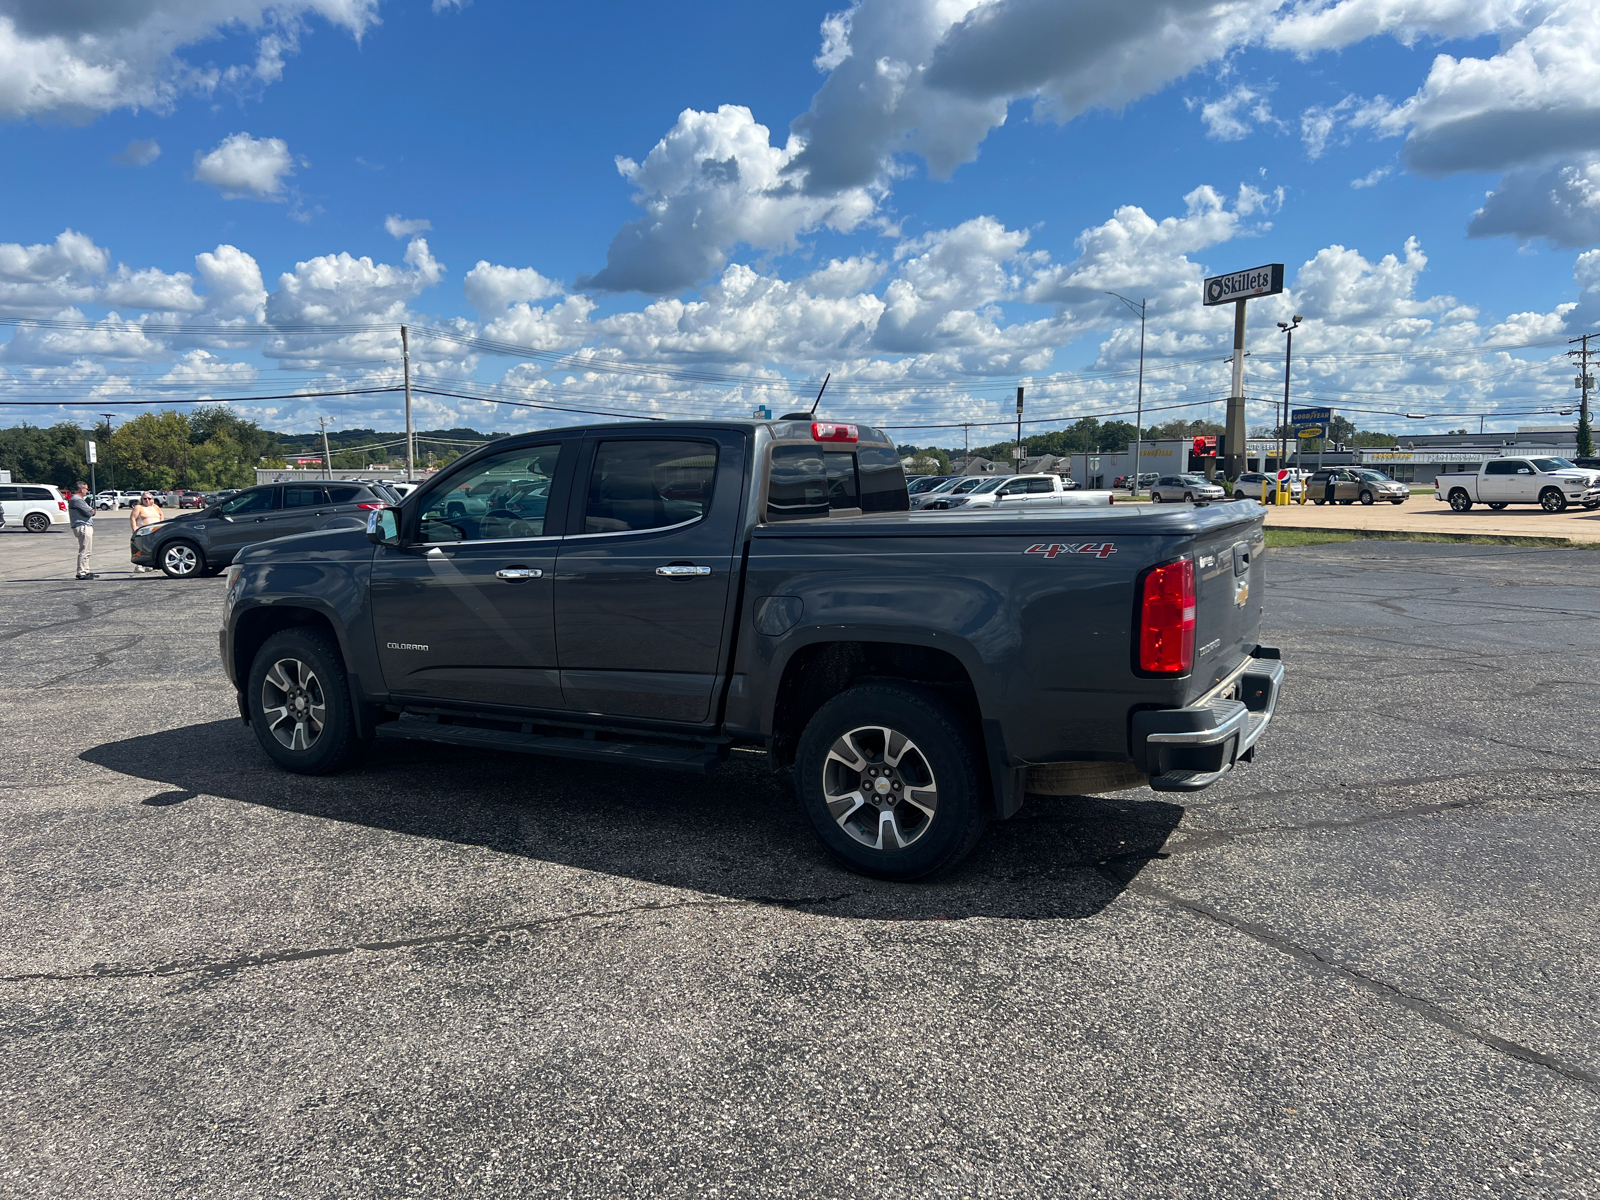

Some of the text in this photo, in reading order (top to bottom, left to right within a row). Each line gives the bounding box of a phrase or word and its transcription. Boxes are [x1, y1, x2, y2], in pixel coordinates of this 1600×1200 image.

[1223, 272, 1269, 295] Skillets
[1293, 411, 1330, 420] GOODYEAR
[1140, 448, 1173, 457] GOODYEAR
[387, 642, 429, 652] COLORADO
